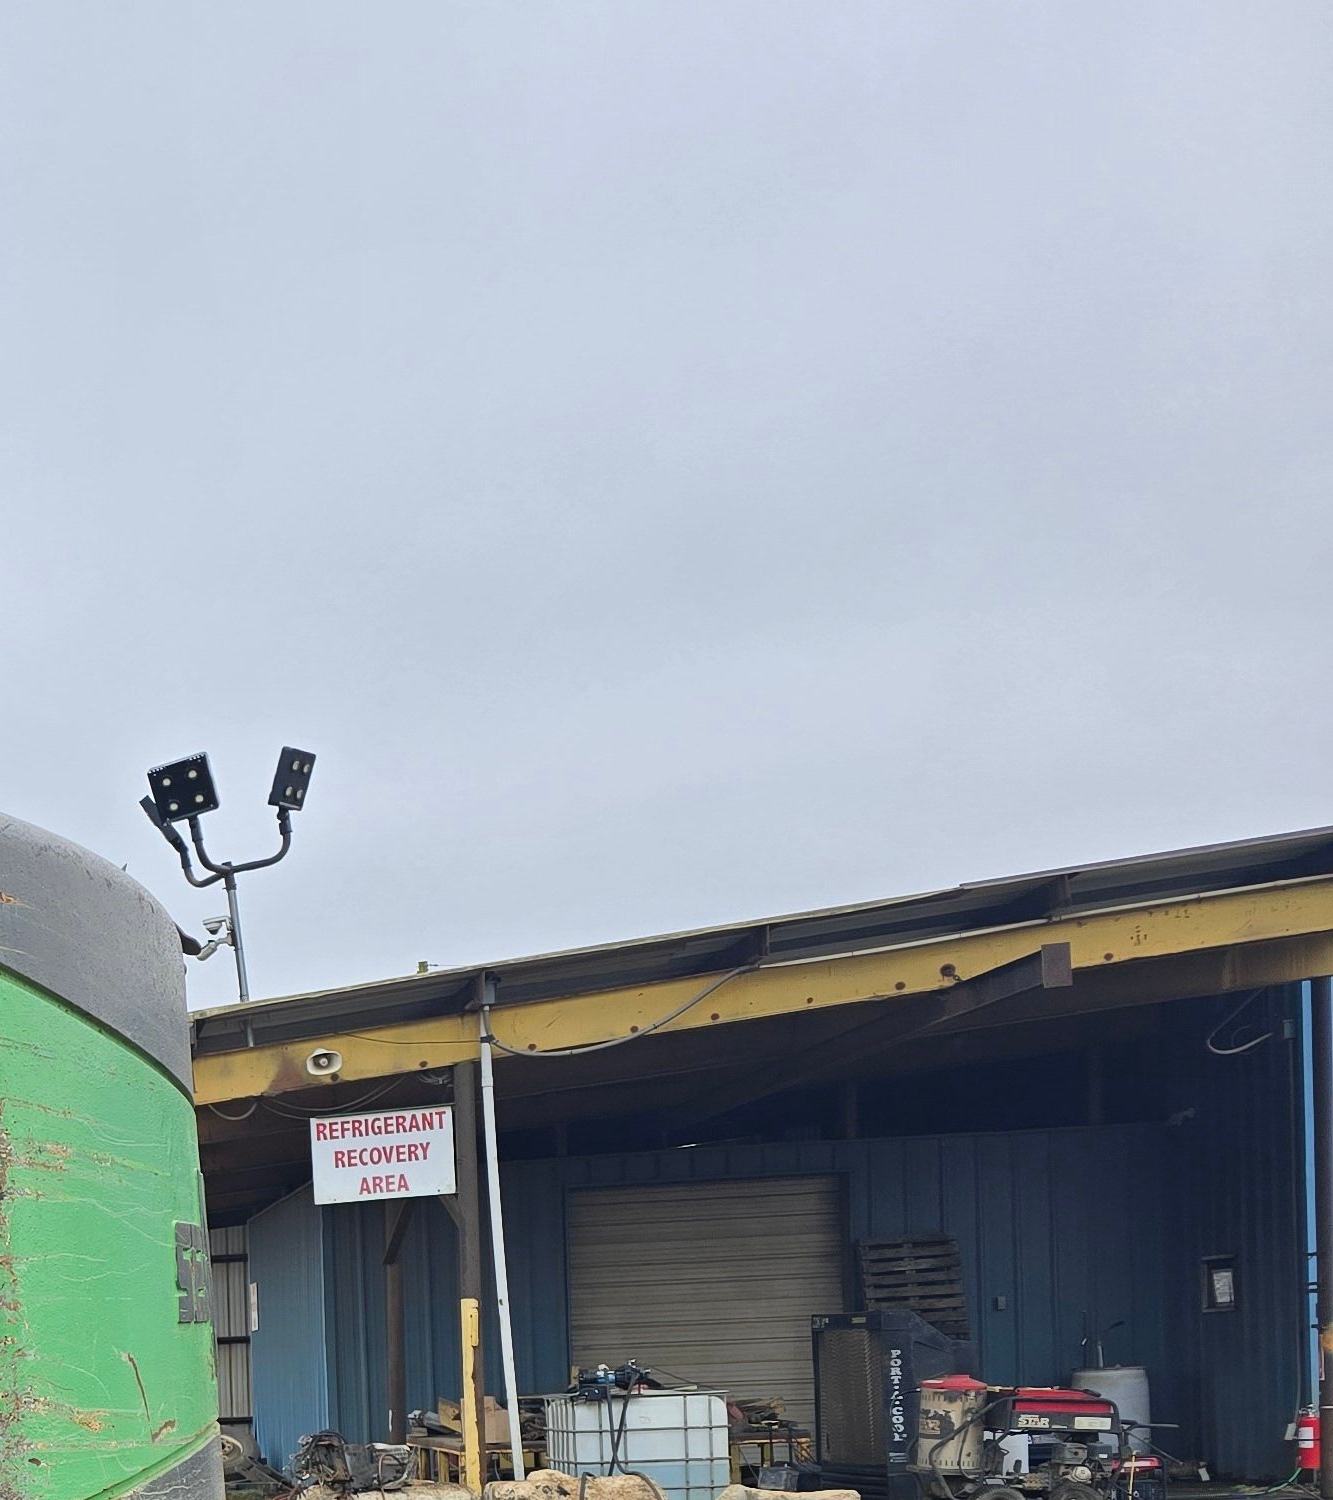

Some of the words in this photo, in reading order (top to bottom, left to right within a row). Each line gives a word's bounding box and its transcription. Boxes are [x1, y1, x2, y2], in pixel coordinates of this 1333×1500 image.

[316, 1111, 446, 1141] REFRIGERANT
[334, 1141, 430, 1168] RECOVERY
[359, 1173, 410, 1195] AREA
